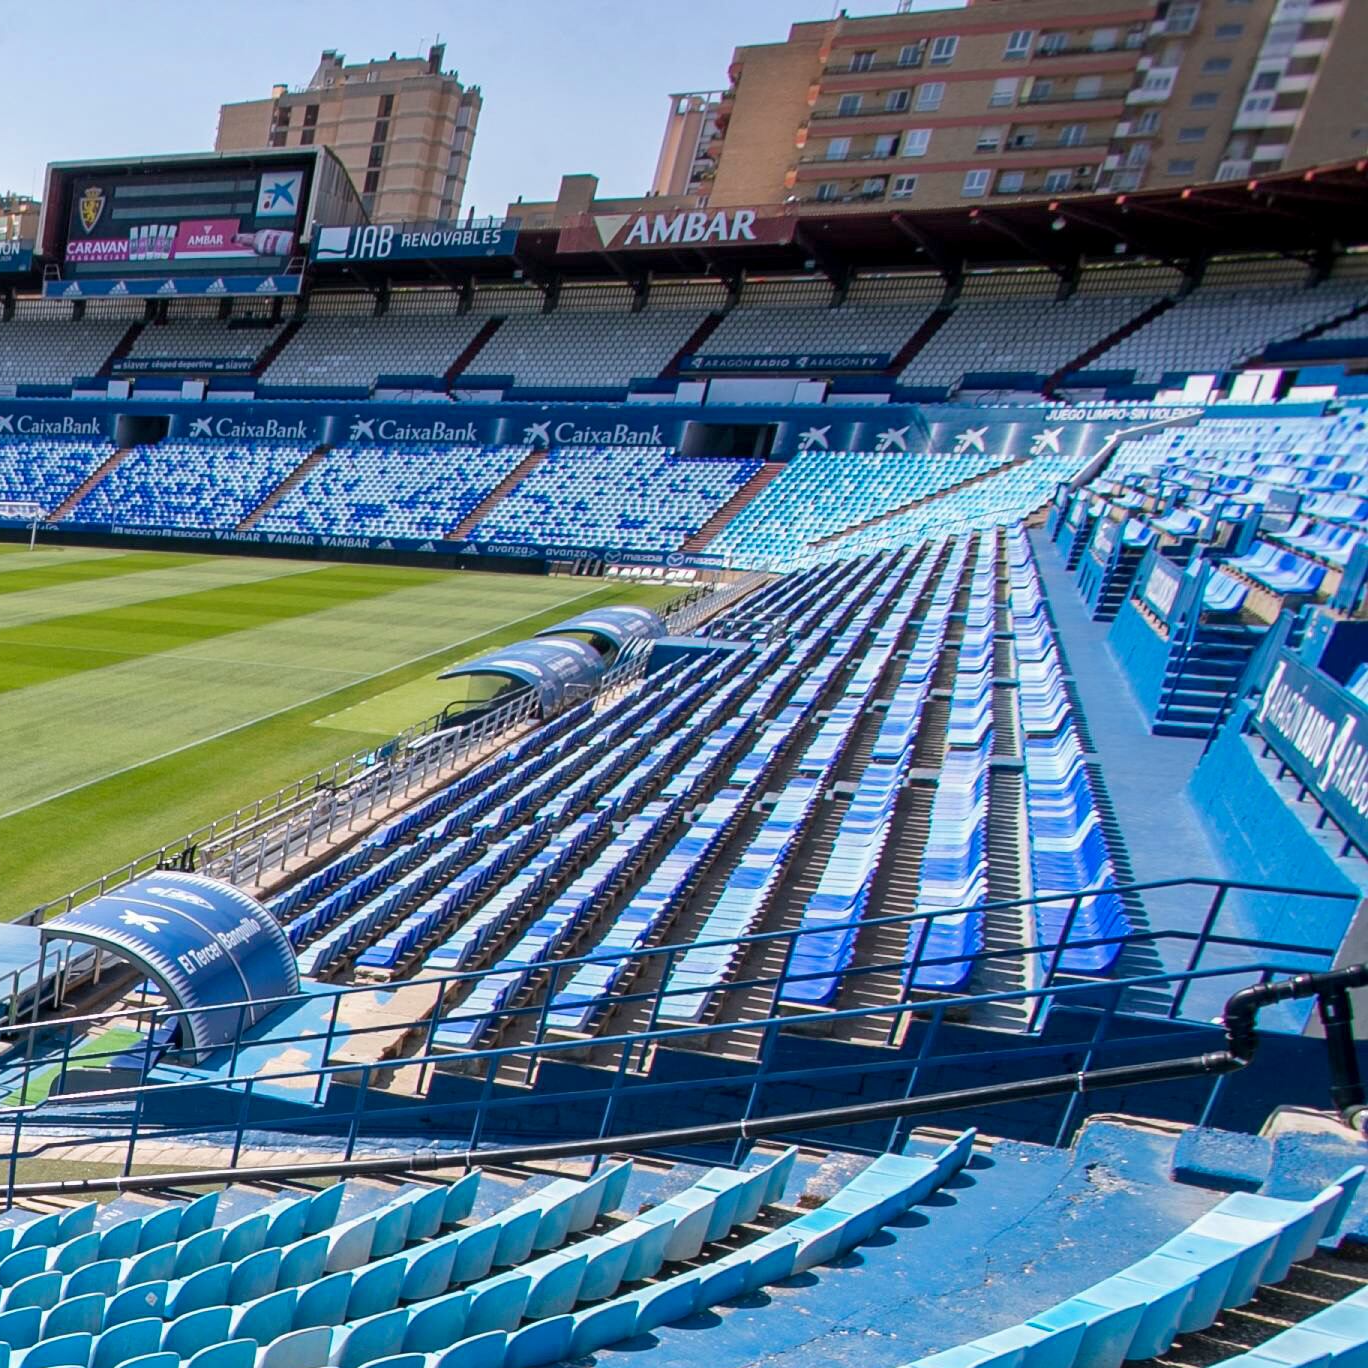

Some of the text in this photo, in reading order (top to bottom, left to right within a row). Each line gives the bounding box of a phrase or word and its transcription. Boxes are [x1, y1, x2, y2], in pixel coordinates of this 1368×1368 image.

[624, 209, 757, 245] AMBAR
[186, 234, 223, 246] AMBAR
[348, 224, 501, 259] JAB RENOVABLES
[67, 240, 128, 254] CARAVAN
[178, 360, 213, 371] deportivo
[753, 358, 790, 367] RADIO
[863, 358, 878, 367] TV
[1045, 408, 1084, 421] JUEGO
[17, 415, 100, 434] CaixaBank
[216, 418, 307, 440] CaixaBank
[378, 420, 477, 442] CaixaBank
[554, 422, 663, 445] CaixaBank
[223, 532, 261, 542] AMBAR
[275, 534, 314, 545] AMBAR
[329, 537, 370, 549] AMBAR
[487, 545, 528, 557] avanza
[545, 548, 587, 559] avanza
[623, 554, 663, 563] mazda
[684, 557, 723, 566] mazda
[177, 917, 262, 975] El Tercer Banquillo
